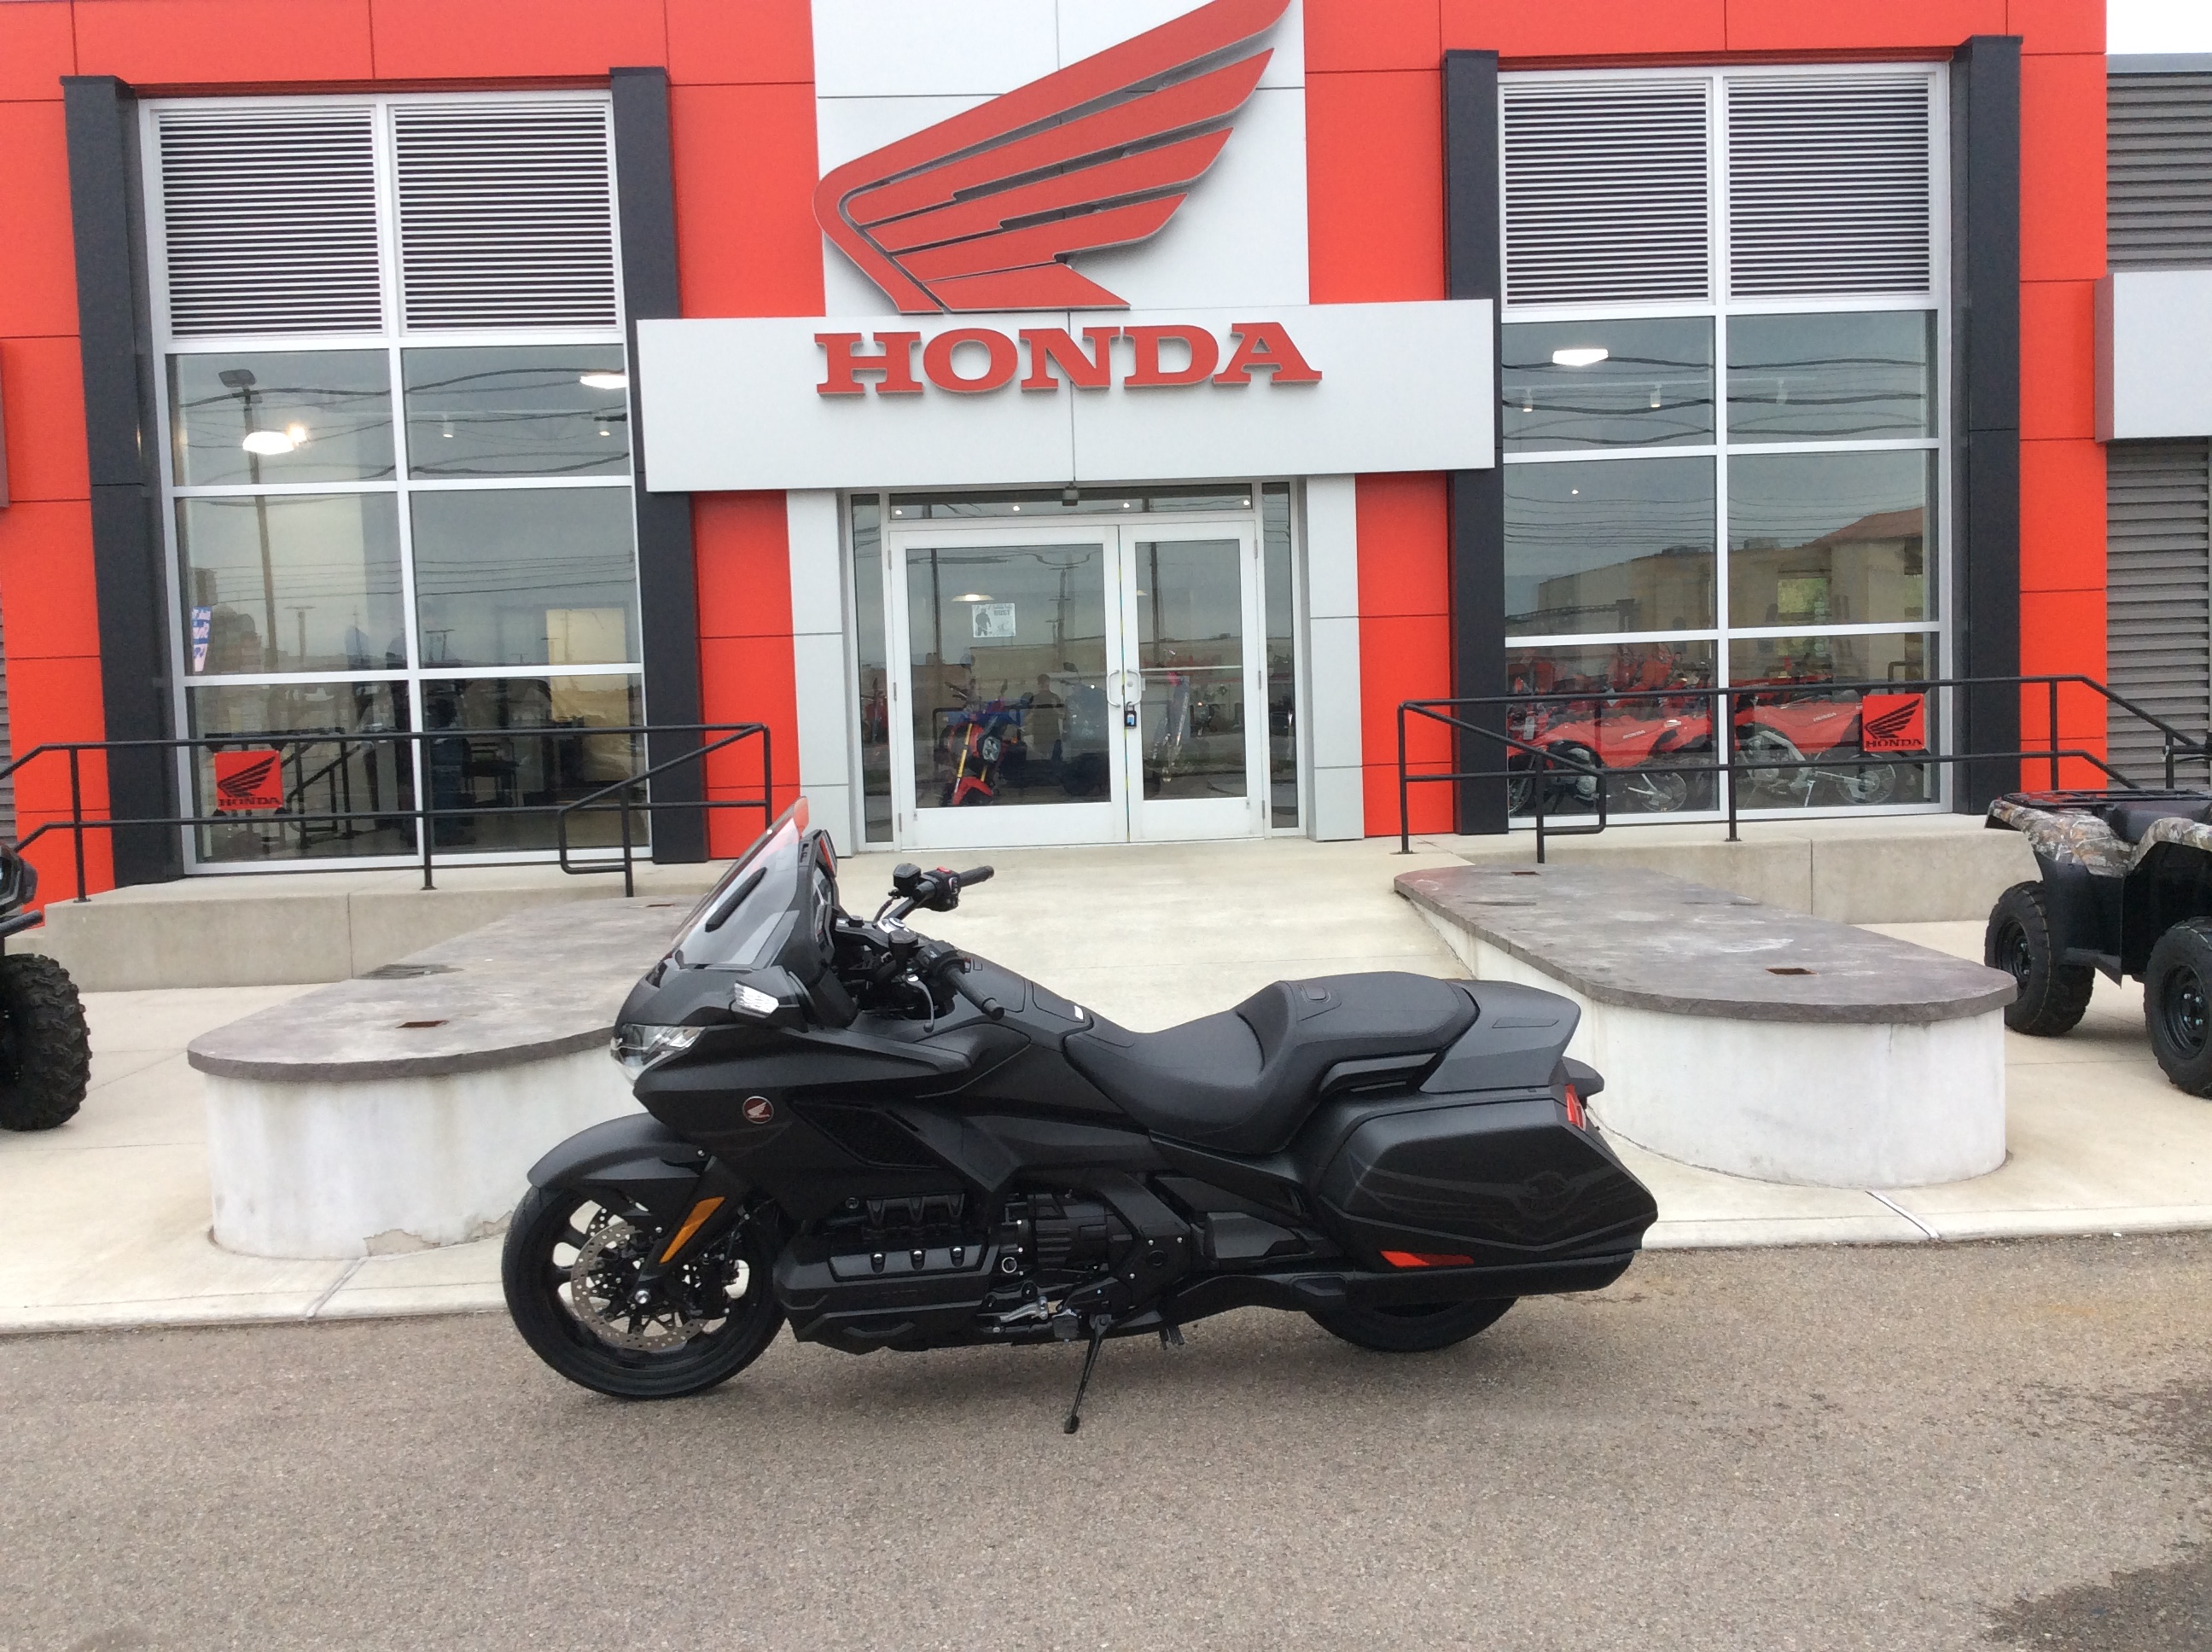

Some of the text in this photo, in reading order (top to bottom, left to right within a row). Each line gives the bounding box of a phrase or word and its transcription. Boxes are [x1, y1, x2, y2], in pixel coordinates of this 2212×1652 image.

[813, 322, 1323, 396] HONDA
[1866, 739, 1923, 747] HONDA
[218, 797, 282, 806] HONDA
